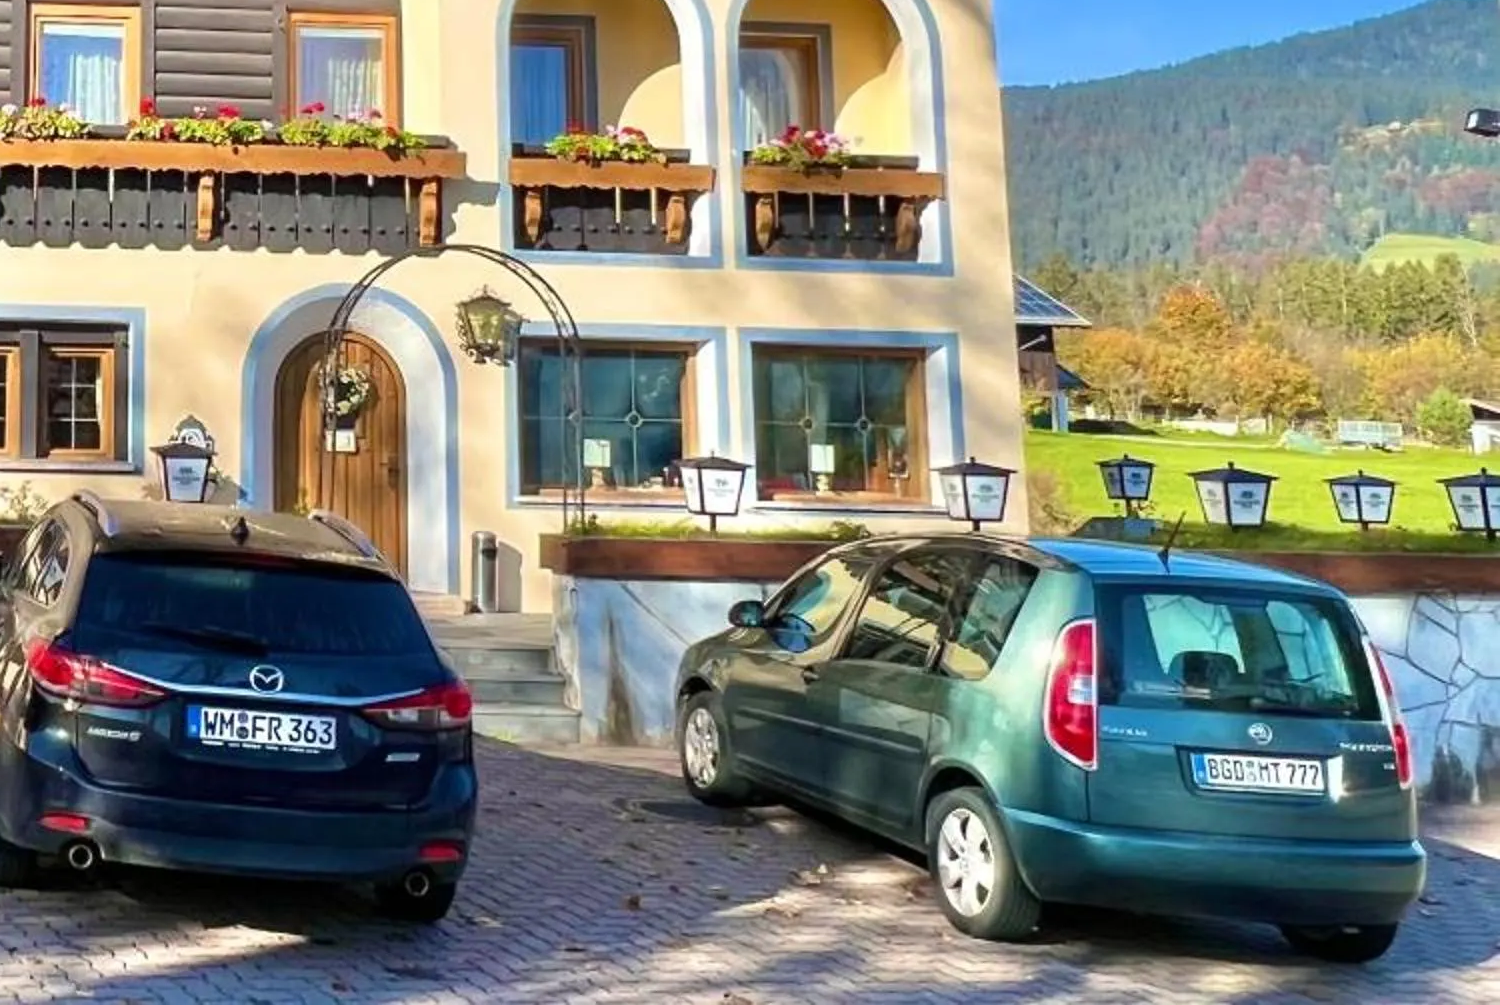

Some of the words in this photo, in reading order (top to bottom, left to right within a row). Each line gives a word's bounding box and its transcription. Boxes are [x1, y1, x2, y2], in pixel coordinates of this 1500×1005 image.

[203, 709, 235, 739] WM
[251, 716, 283, 742] FR
[288, 718, 333, 745] 363
[1207, 758, 1245, 781] BGD
[1285, 762, 1320, 786] 777
